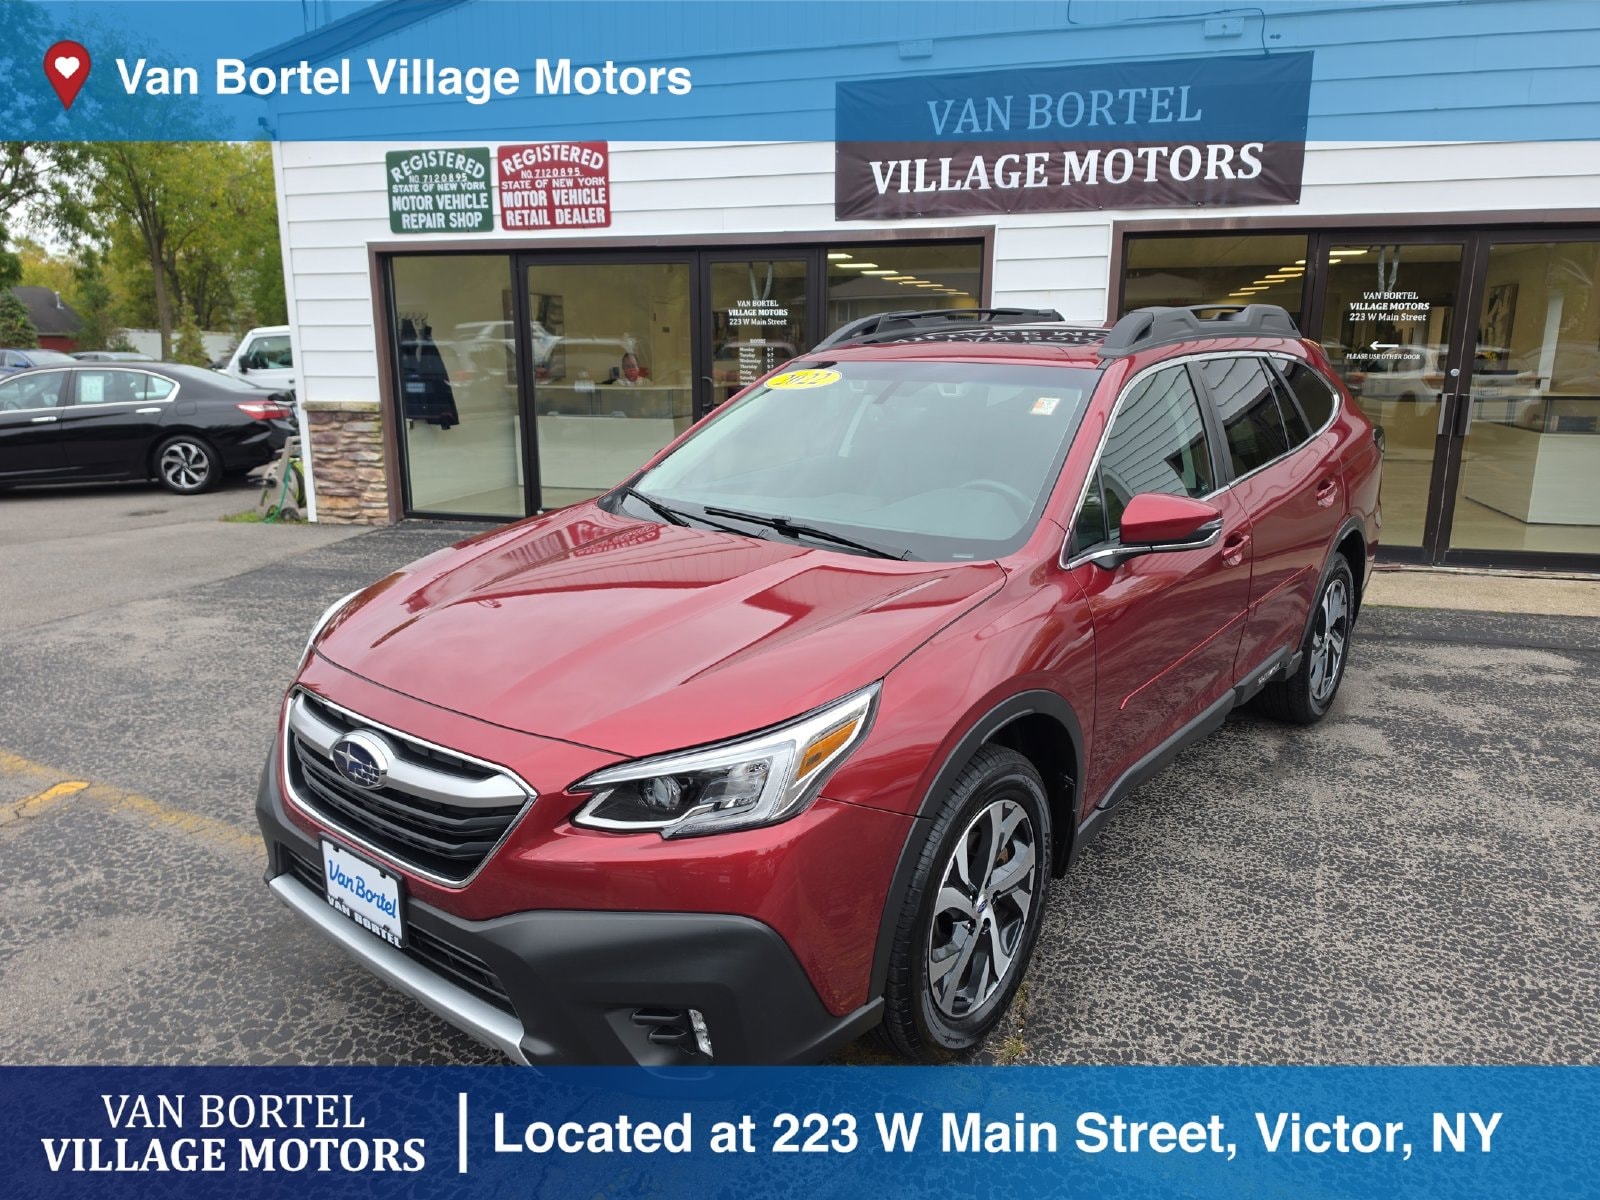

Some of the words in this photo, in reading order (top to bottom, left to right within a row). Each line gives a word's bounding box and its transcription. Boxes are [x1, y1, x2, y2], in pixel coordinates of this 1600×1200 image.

[927, 96, 1014, 135] VAN
[1028, 85, 1202, 130] BORTEL
[391, 150, 486, 183] REGISTERED
[502, 144, 604, 176] REGISTERED
[868, 152, 1050, 195] VILLAGE
[1062, 142, 1265, 187] MOTORS
[423, 172, 468, 182] 7120895
[534, 167, 581, 177] 7120895
[392, 184, 420, 193] STATE
[423, 184, 434, 192] OF
[437, 183, 457, 191] NEW
[460, 181, 487, 190] YORK
[501, 180, 531, 190] STATE
[535, 179, 548, 188] OF
[552, 178, 574, 187] NEW
[578, 176, 606, 186] YORK
[392, 194, 434, 212] MOTOR
[437, 192, 489, 209] VEHICLE
[502, 190, 548, 208] MOTOR
[552, 187, 607, 205] VEHICLE
[401, 213, 446, 230] REPAIR
[449, 211, 483, 228] SHOP
[505, 208, 551, 227] RETAIL
[555, 207, 606, 225] DEALER
[1363, 291, 1382, 300] VAN
[1383, 291, 1419, 300] BORTEL
[728, 308, 758, 316] VILLAGE
[758, 308, 788, 316] MOTORS
[1349, 302, 1388, 311] VILLAGE
[1389, 302, 1430, 311] MOTORS
[768, 318, 787, 326] Street
[1349, 312, 1366, 321] 223
[1367, 312, 1377, 321] W
[1378, 312, 1399, 321] Main
[1400, 312, 1427, 321] Street
[328, 859, 355, 893] Van
[355, 875, 397, 919] Bortel
[327, 894, 351, 917] VAN
[354, 911, 402, 949] BORTEL
